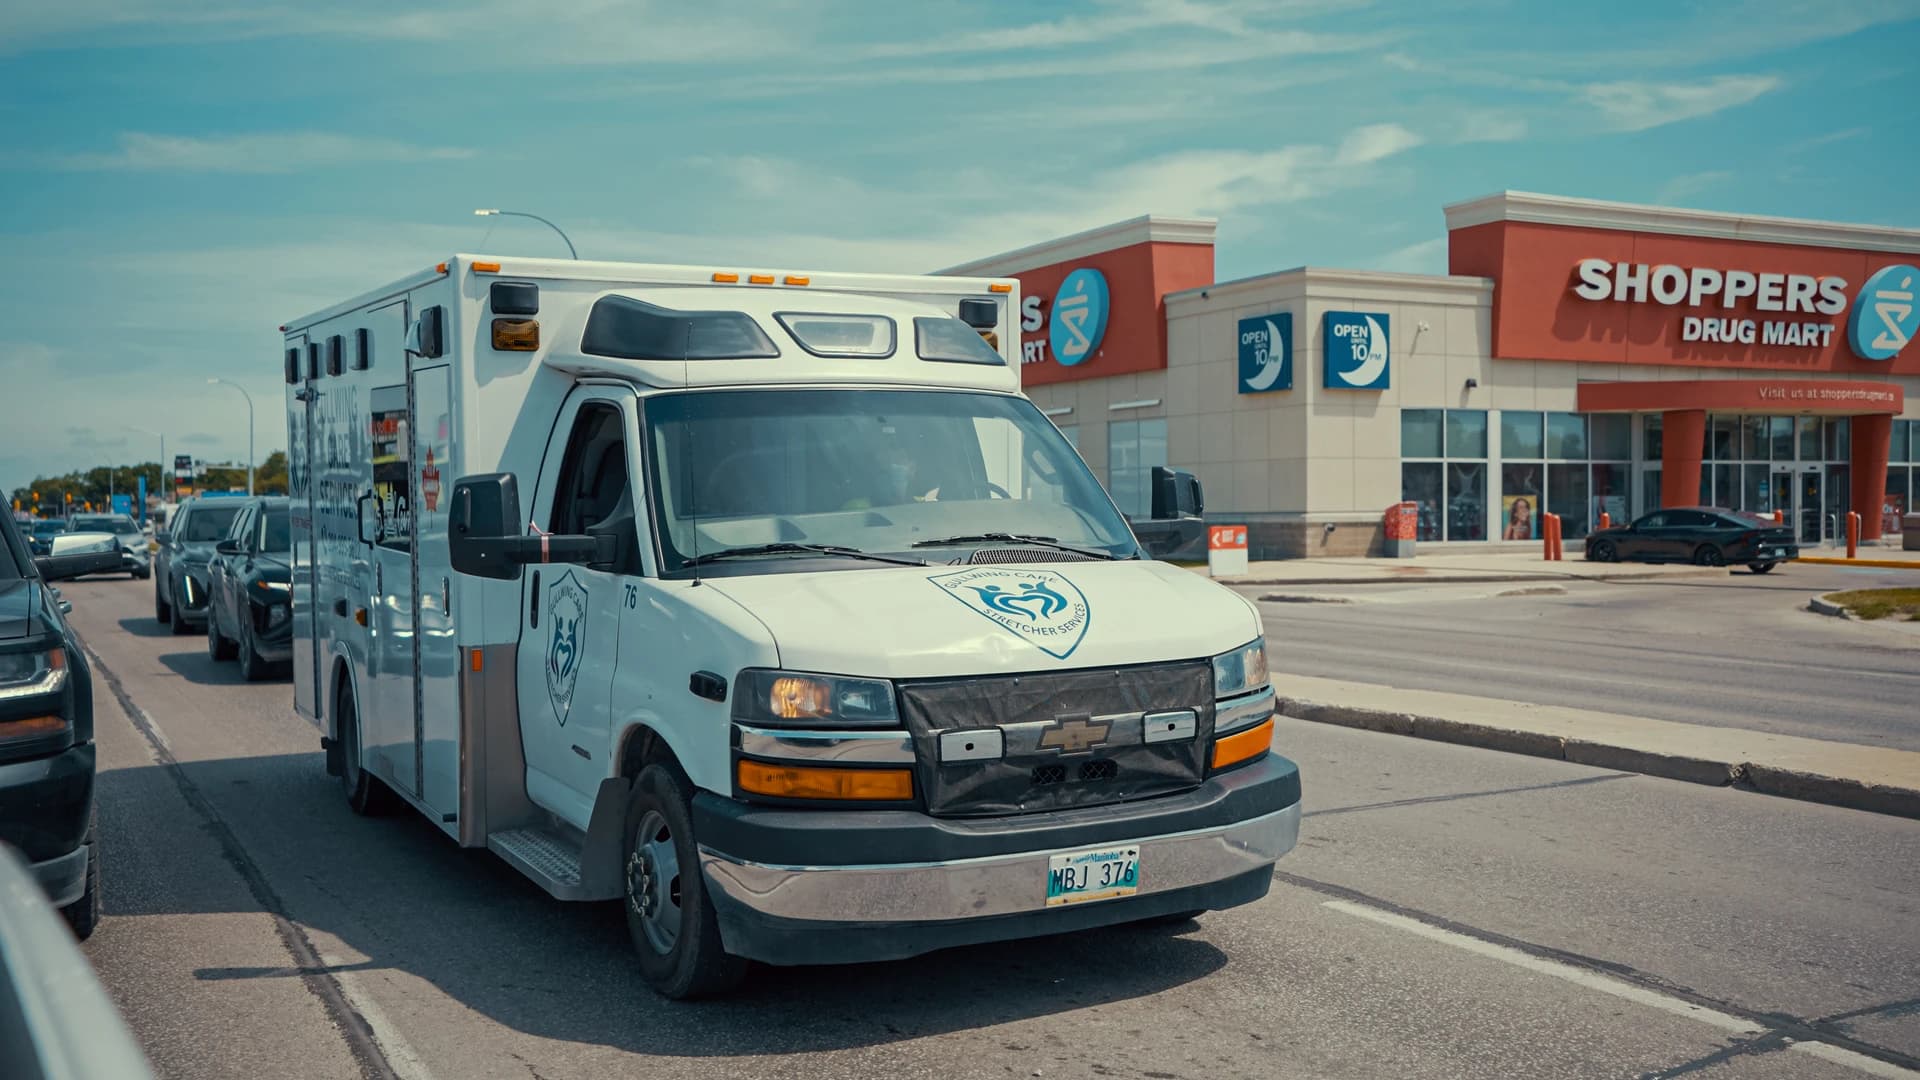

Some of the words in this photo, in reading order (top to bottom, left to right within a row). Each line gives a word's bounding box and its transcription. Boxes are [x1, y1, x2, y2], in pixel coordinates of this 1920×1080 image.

[1575, 257, 1848, 316] SHOPPERS
[1241, 330, 1268, 345] OPEN
[1334, 323, 1368, 338] OPEN
[1682, 316, 1756, 345] DRUG
[1762, 320, 1835, 348] MART
[1254, 348, 1268, 366] 10
[1351, 344, 1367, 361] 10
[1369, 352, 1382, 361] PM
[1759, 386, 1785, 399] Visit
[1791, 389, 1804, 398] us
[1807, 388, 1817, 399] at
[944, 570, 1010, 589] GULLWING
[1014, 572, 1058, 584] CARE
[624, 583, 637, 610] 76
[983, 608, 1057, 636] STRETCHER
[1057, 602, 1087, 634] SERVICES
[1051, 865, 1088, 895] MBJ
[1101, 860, 1135, 887] 376
